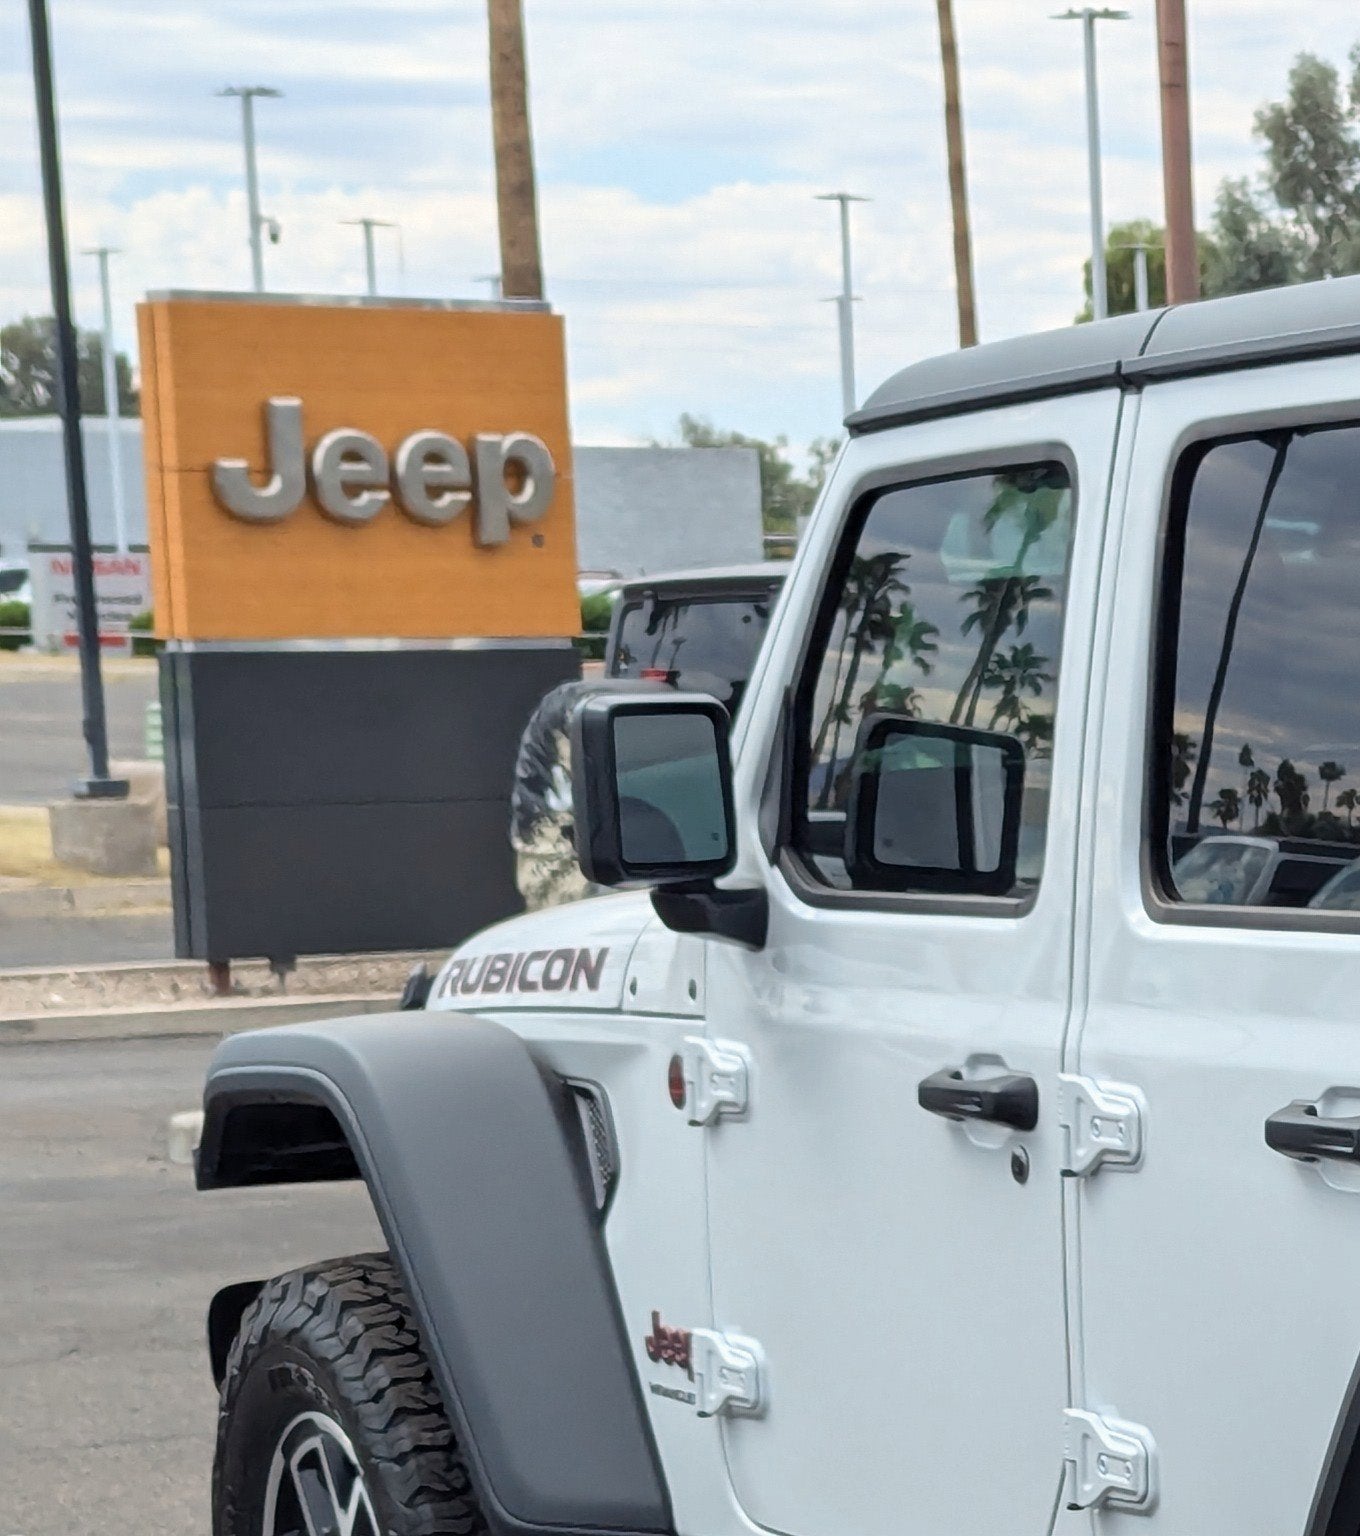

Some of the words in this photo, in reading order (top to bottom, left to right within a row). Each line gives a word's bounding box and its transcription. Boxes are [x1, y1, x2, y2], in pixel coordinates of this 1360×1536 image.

[210, 396, 556, 549] Jeep
[51, 559, 140, 575] NSAN
[437, 947, 610, 998] RUBICON
